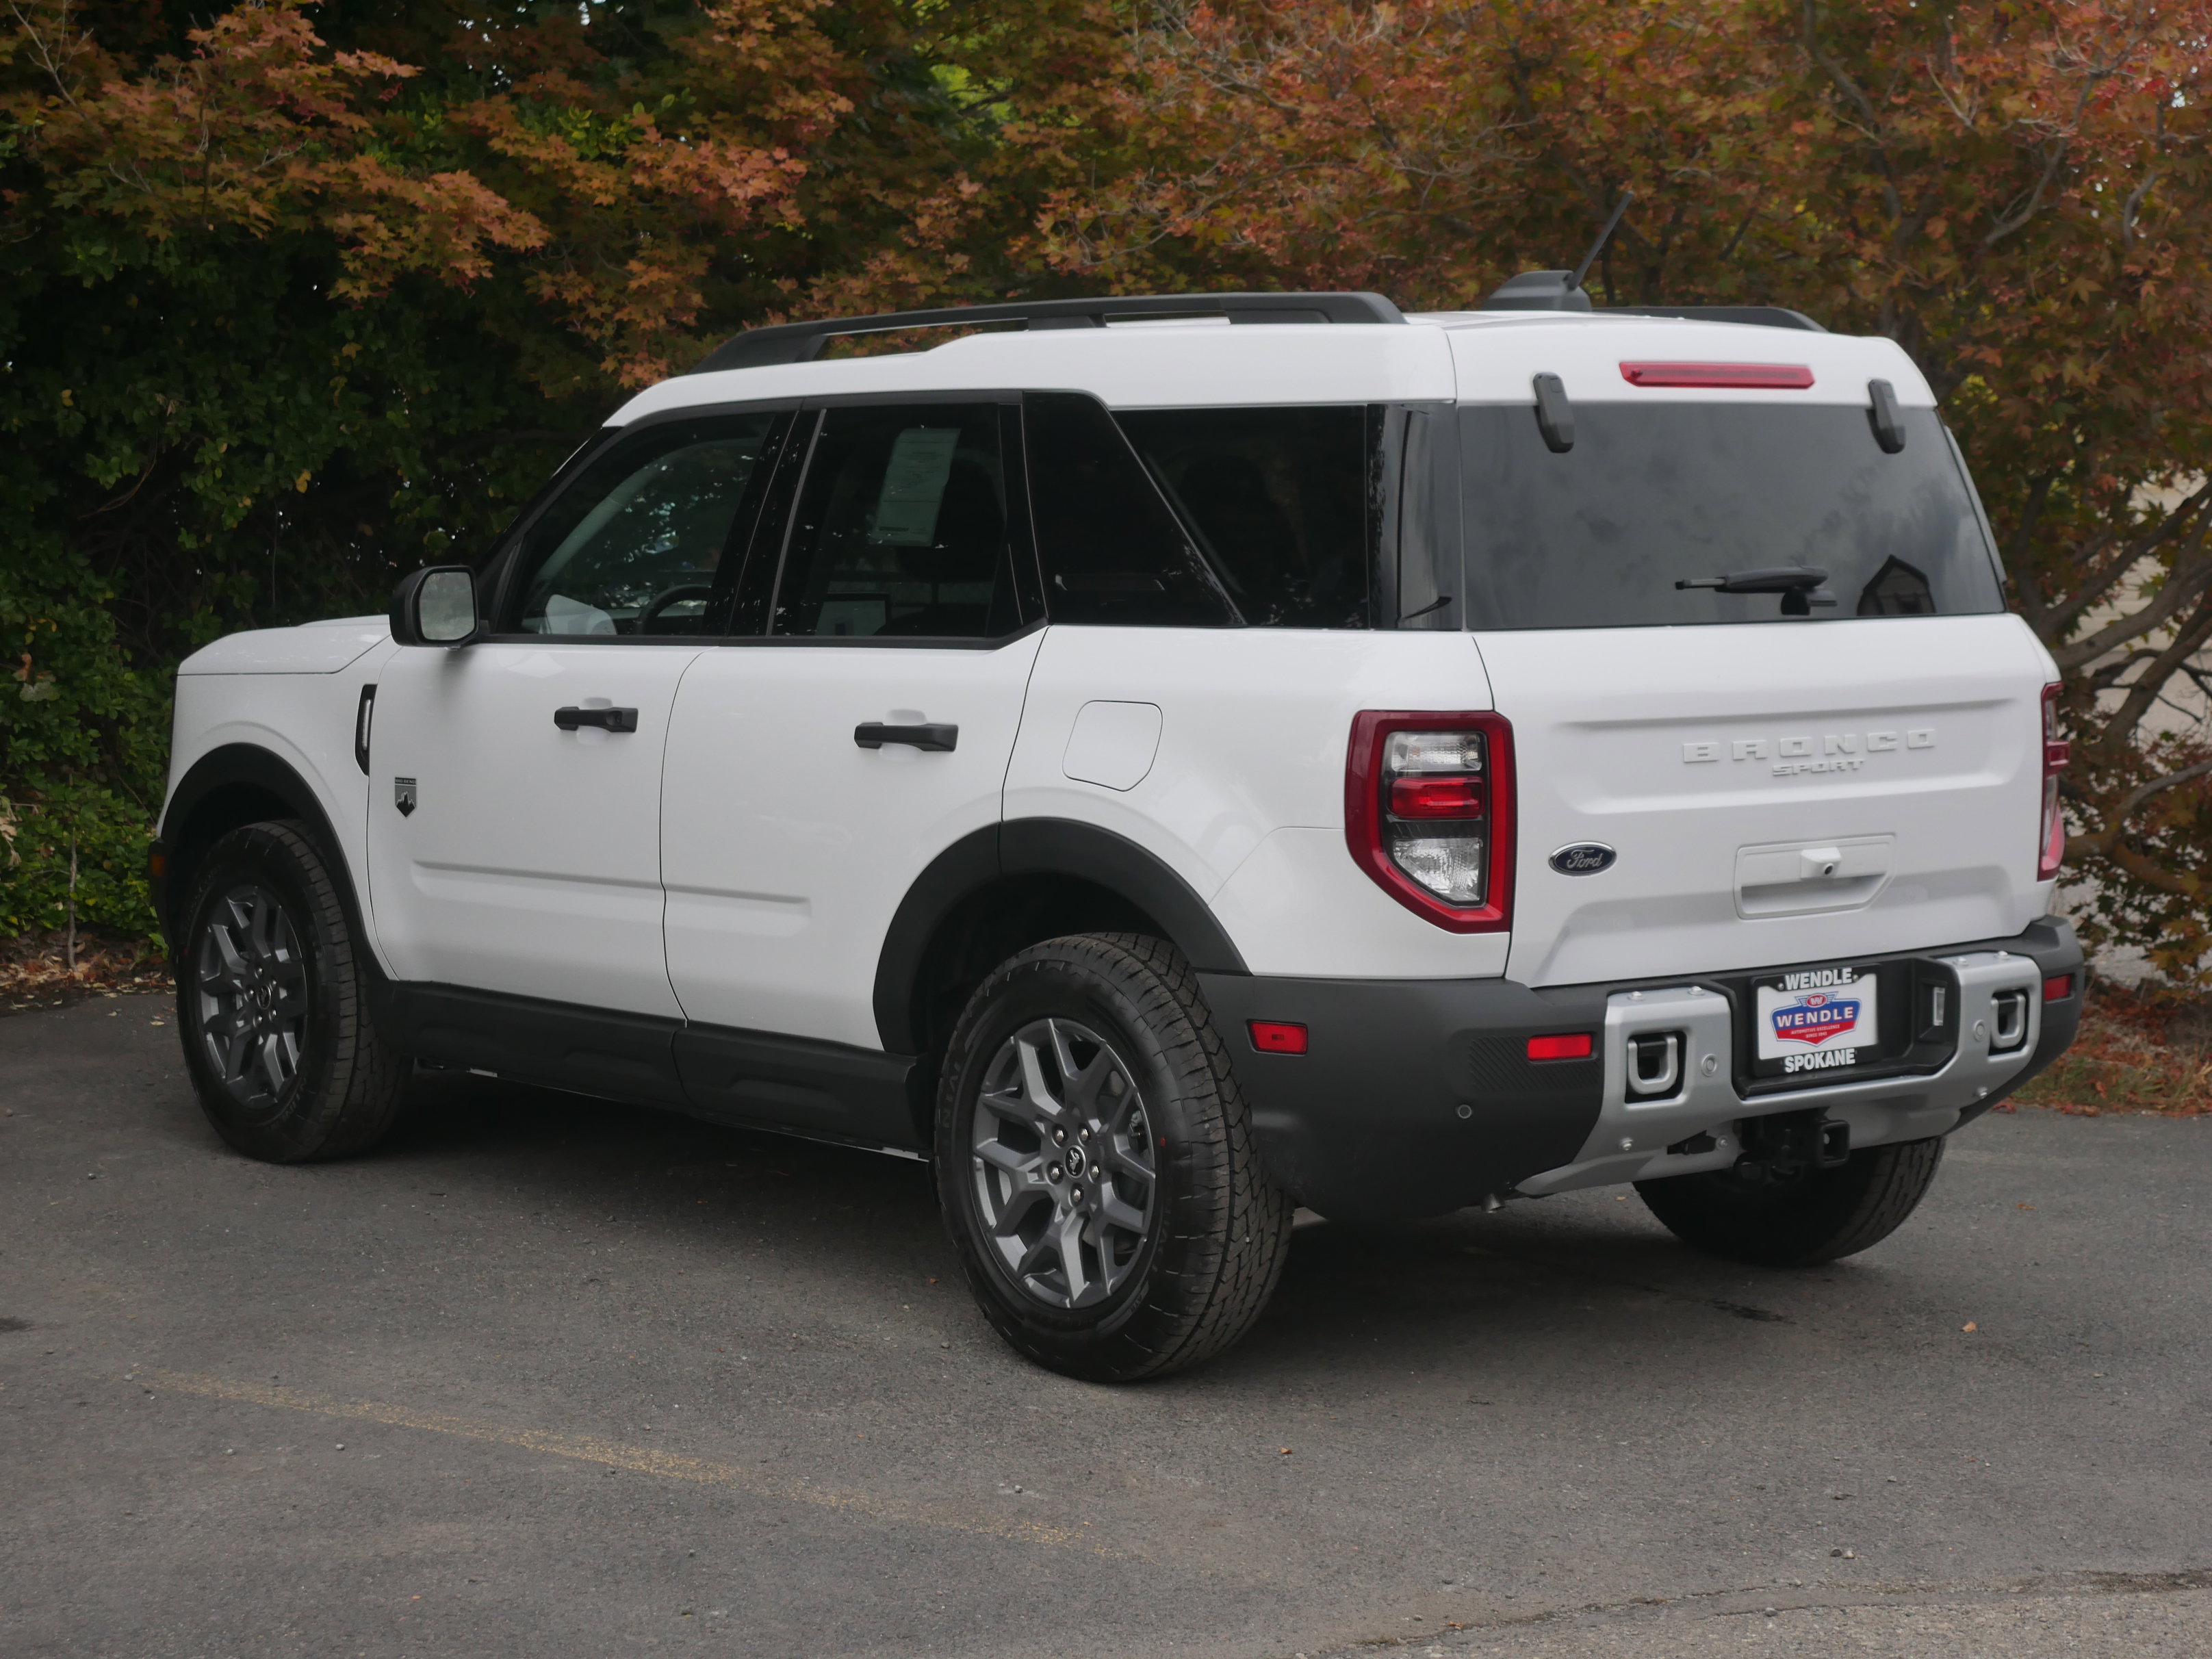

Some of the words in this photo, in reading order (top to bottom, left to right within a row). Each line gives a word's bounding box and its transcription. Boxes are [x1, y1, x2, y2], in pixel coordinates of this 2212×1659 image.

[1683, 729, 1936, 763] BRONCO
[1773, 758, 1864, 776] SPORT
[1567, 849, 1604, 869] Ford
[1785, 968, 1853, 990] WENDLE
[1777, 1007, 1853, 1027] WENDLE
[1784, 1049, 1855, 1073] SPOKANE
